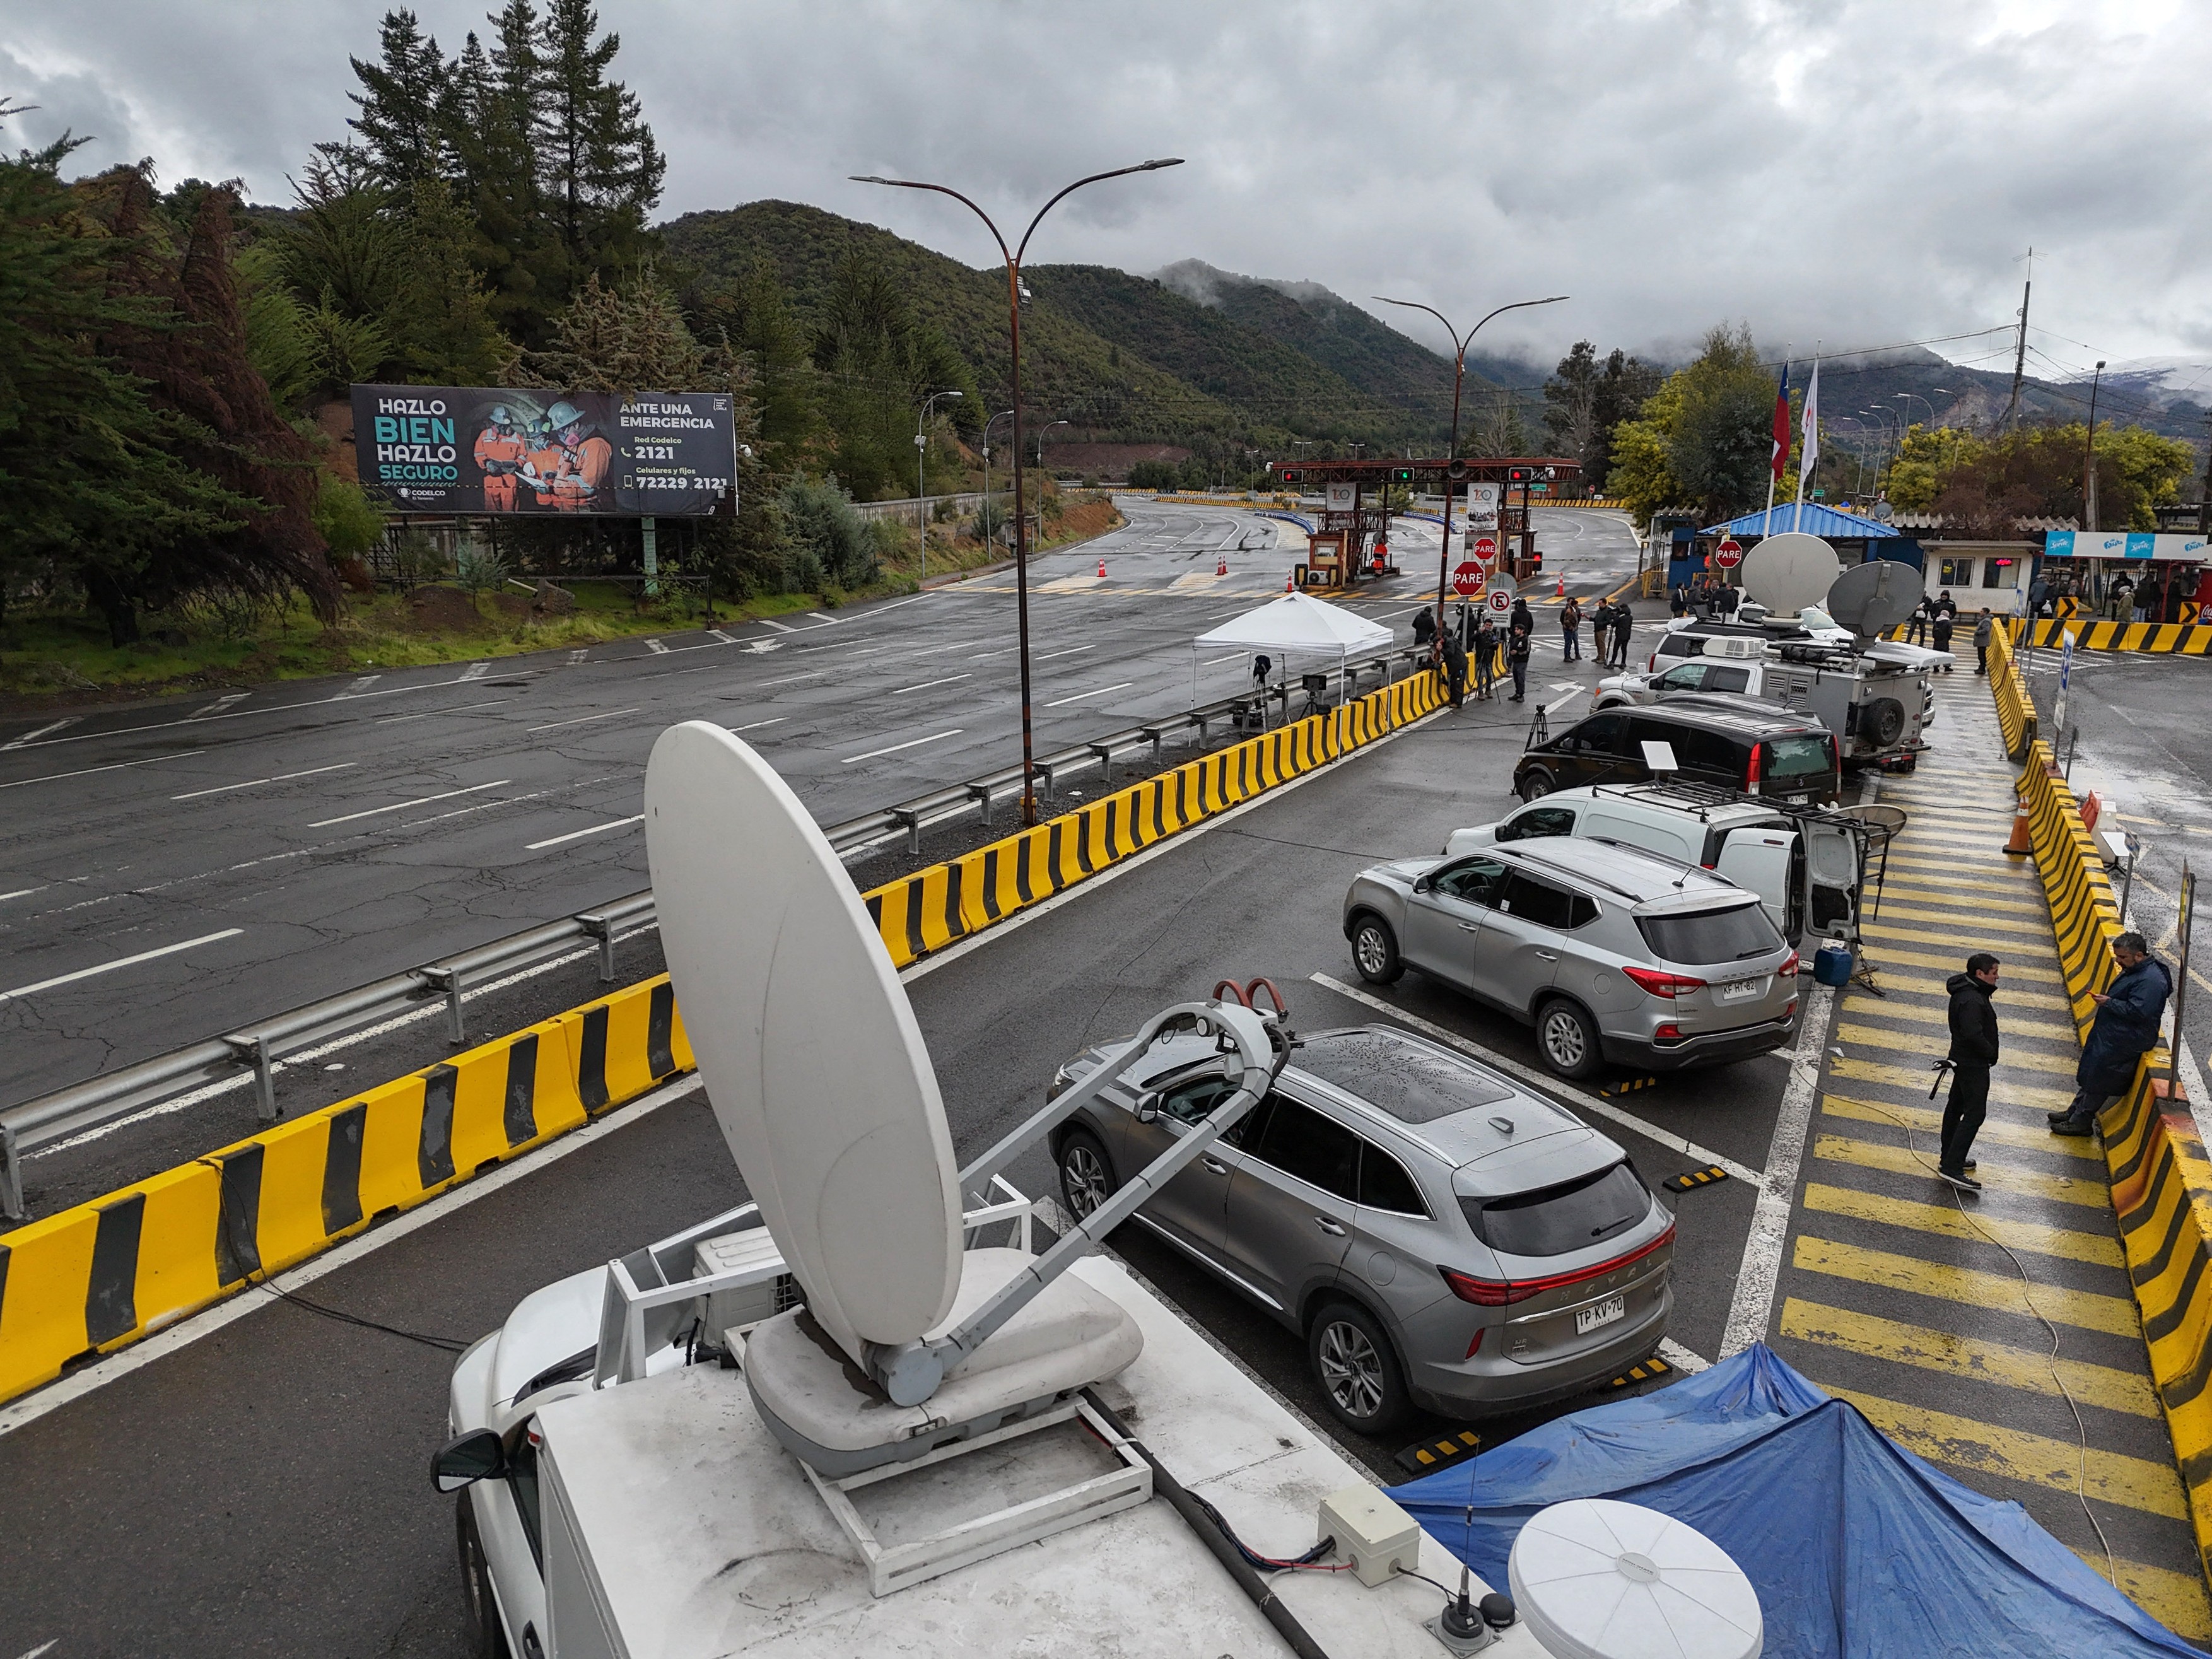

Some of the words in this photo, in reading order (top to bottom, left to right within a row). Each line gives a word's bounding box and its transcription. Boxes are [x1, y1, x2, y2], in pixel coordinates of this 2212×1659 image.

[378, 398, 446, 415] HAZLO
[619, 402, 658, 414] ANTE
[661, 404, 693, 415] UNA
[620, 416, 715, 429] EMERGENCIA
[374, 416, 455, 444] BIEN
[377, 444, 456, 462] HAZLO
[635, 446, 674, 459] 2121
[378, 464, 458, 480] SEGURO
[636, 476, 688, 489] 72229
[694, 478, 727, 489] 2121
[1717, 550, 1740, 559] PARE
[1454, 573, 1482, 584] PARE
[1560, 1259, 1652, 1301] HAVAL
